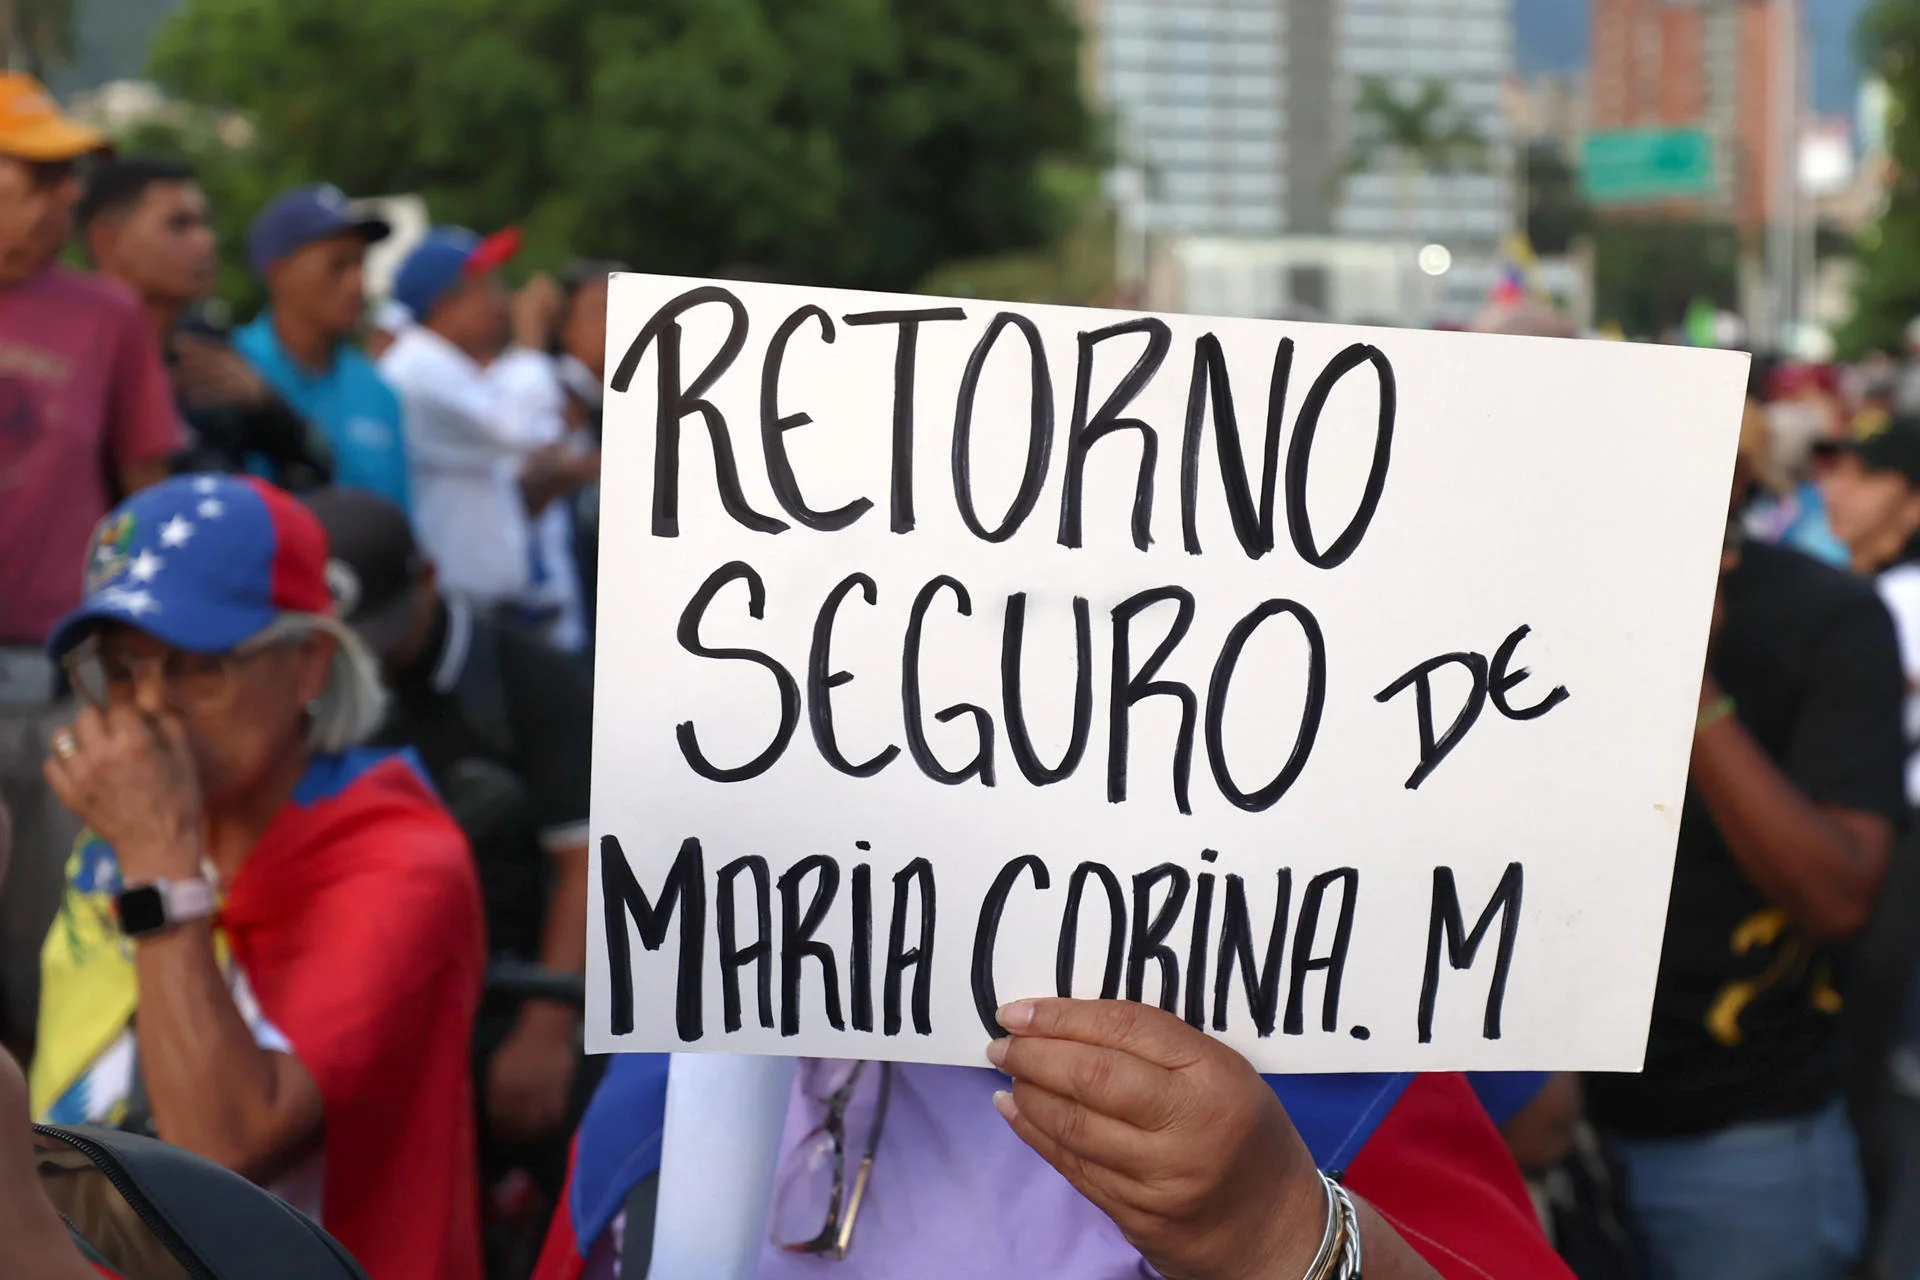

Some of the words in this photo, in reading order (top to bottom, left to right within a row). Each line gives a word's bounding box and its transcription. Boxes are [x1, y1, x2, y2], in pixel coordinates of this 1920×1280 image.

[611, 286, 1396, 570] RETORNO
[676, 560, 1327, 815] SEGURO
[1374, 623, 1570, 791] DE
[1417, 861, 1524, 1044] M
